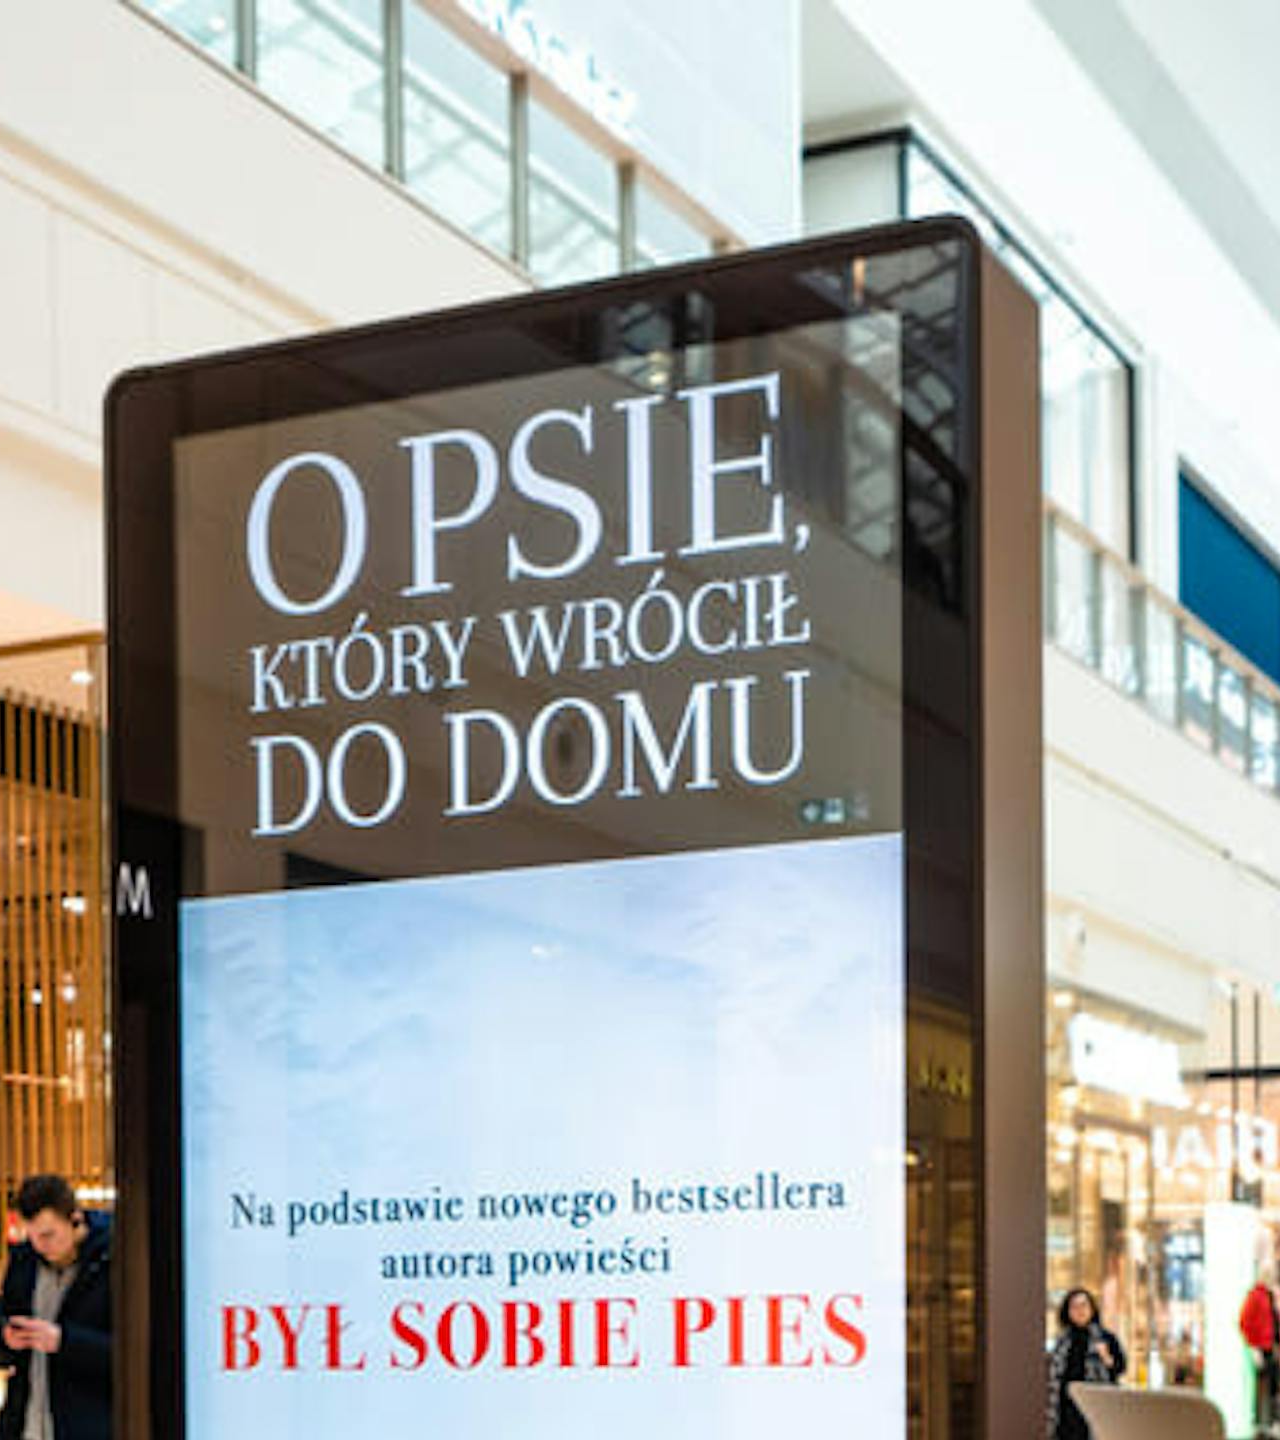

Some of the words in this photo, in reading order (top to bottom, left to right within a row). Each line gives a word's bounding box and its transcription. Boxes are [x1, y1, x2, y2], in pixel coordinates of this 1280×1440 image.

[246, 451, 368, 616] O
[397, 371, 811, 598] PSIE,
[249, 612, 478, 714] KTÓRY
[499, 570, 812, 679] WRÓCIŁ
[250, 722, 408, 837] DO
[444, 669, 813, 818] DOMU
[230, 1192, 276, 1229] Na
[286, 1184, 464, 1238] podstawie
[477, 1190, 617, 1230] nowego
[631, 1171, 847, 1215] bestsellera
[380, 1250, 496, 1281] autora
[506, 1236, 673, 1288] powieści
[220, 1301, 366, 1373] BYŁ
[389, 1295, 641, 1372] SOBIE
[669, 1292, 868, 1370] PIES
